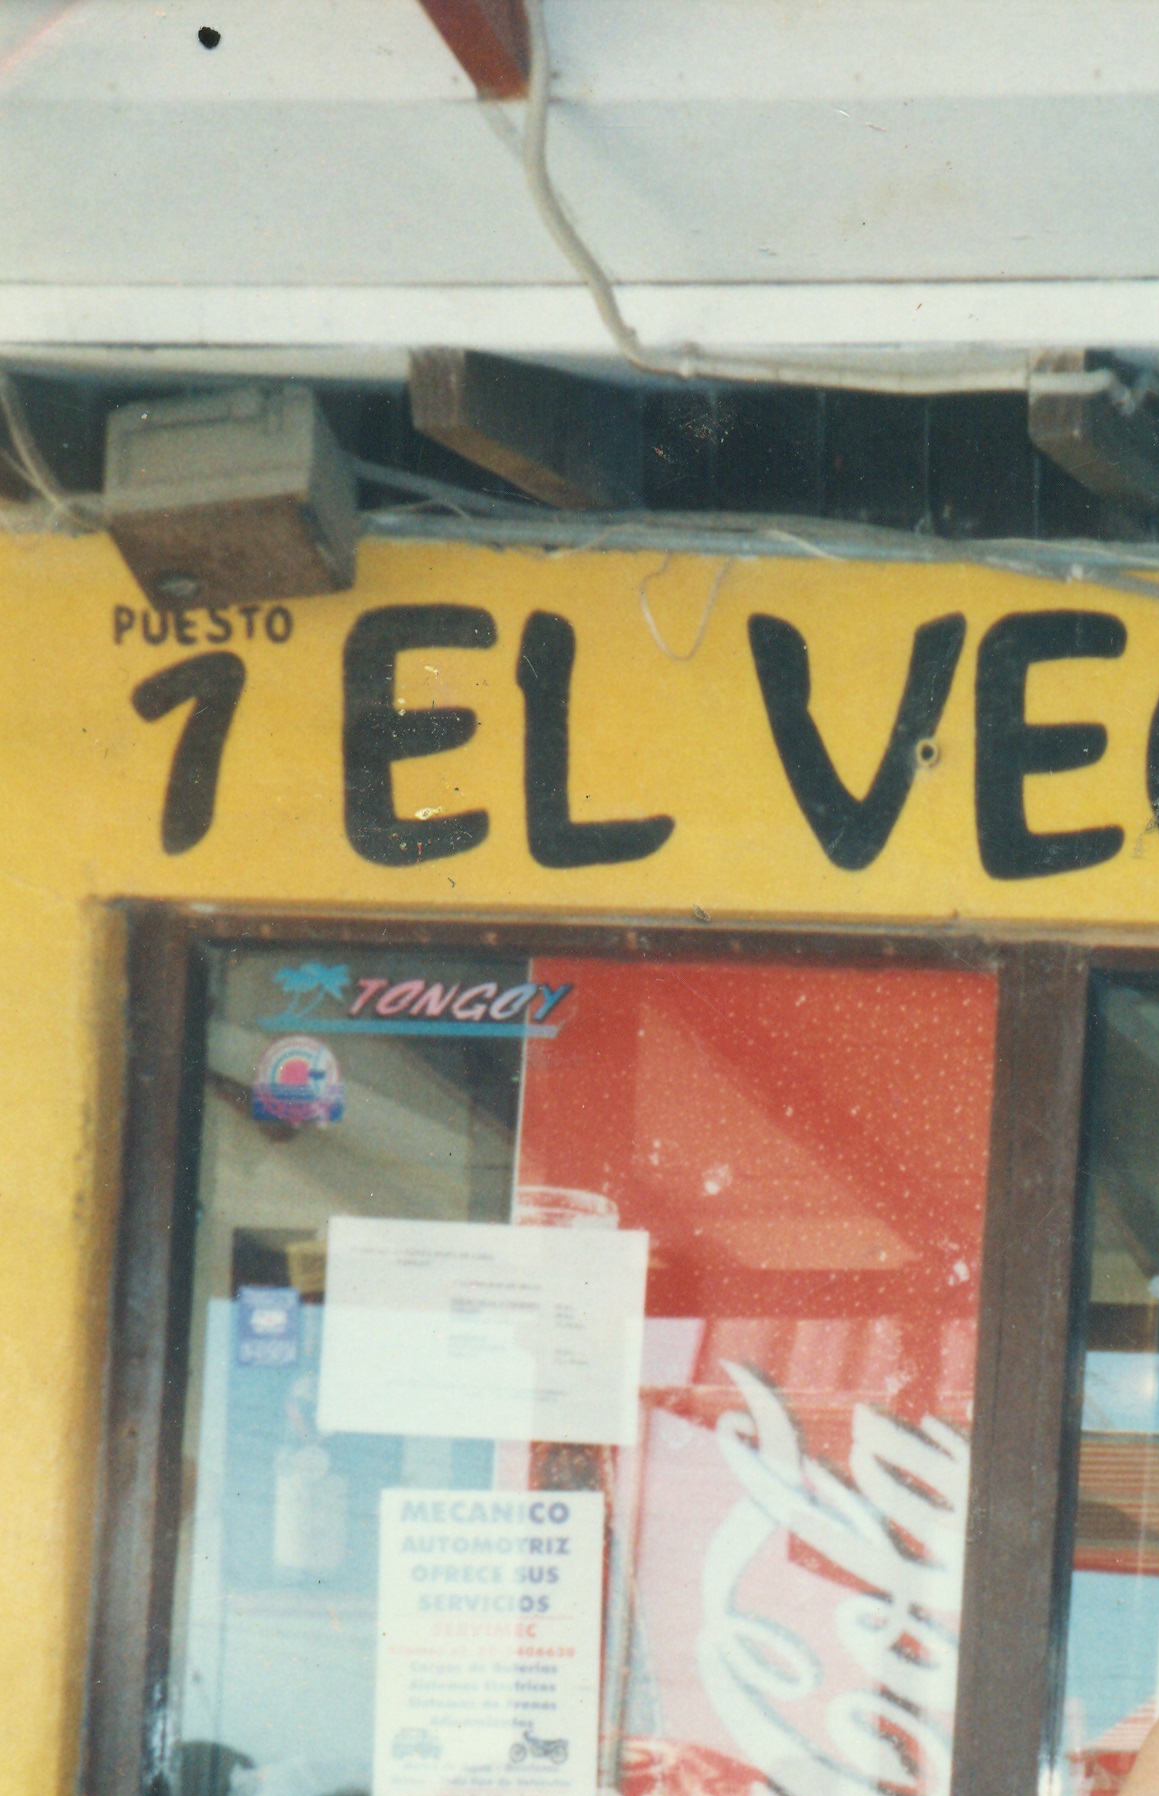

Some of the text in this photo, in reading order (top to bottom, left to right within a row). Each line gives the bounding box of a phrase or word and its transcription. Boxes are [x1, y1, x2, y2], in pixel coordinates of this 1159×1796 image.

[114, 604, 293, 646] PUESTO
[342, 603, 676, 869] EL
[130, 650, 247, 856] 1
[350, 979, 574, 1021] TONGOY
[401, 1501, 570, 1524] MECANICO
[402, 1536, 570, 1555] AUTOMOTRIZ
[411, 1565, 560, 1584] OFRECE SUS
[419, 1595, 550, 1613] SERVICIOS
